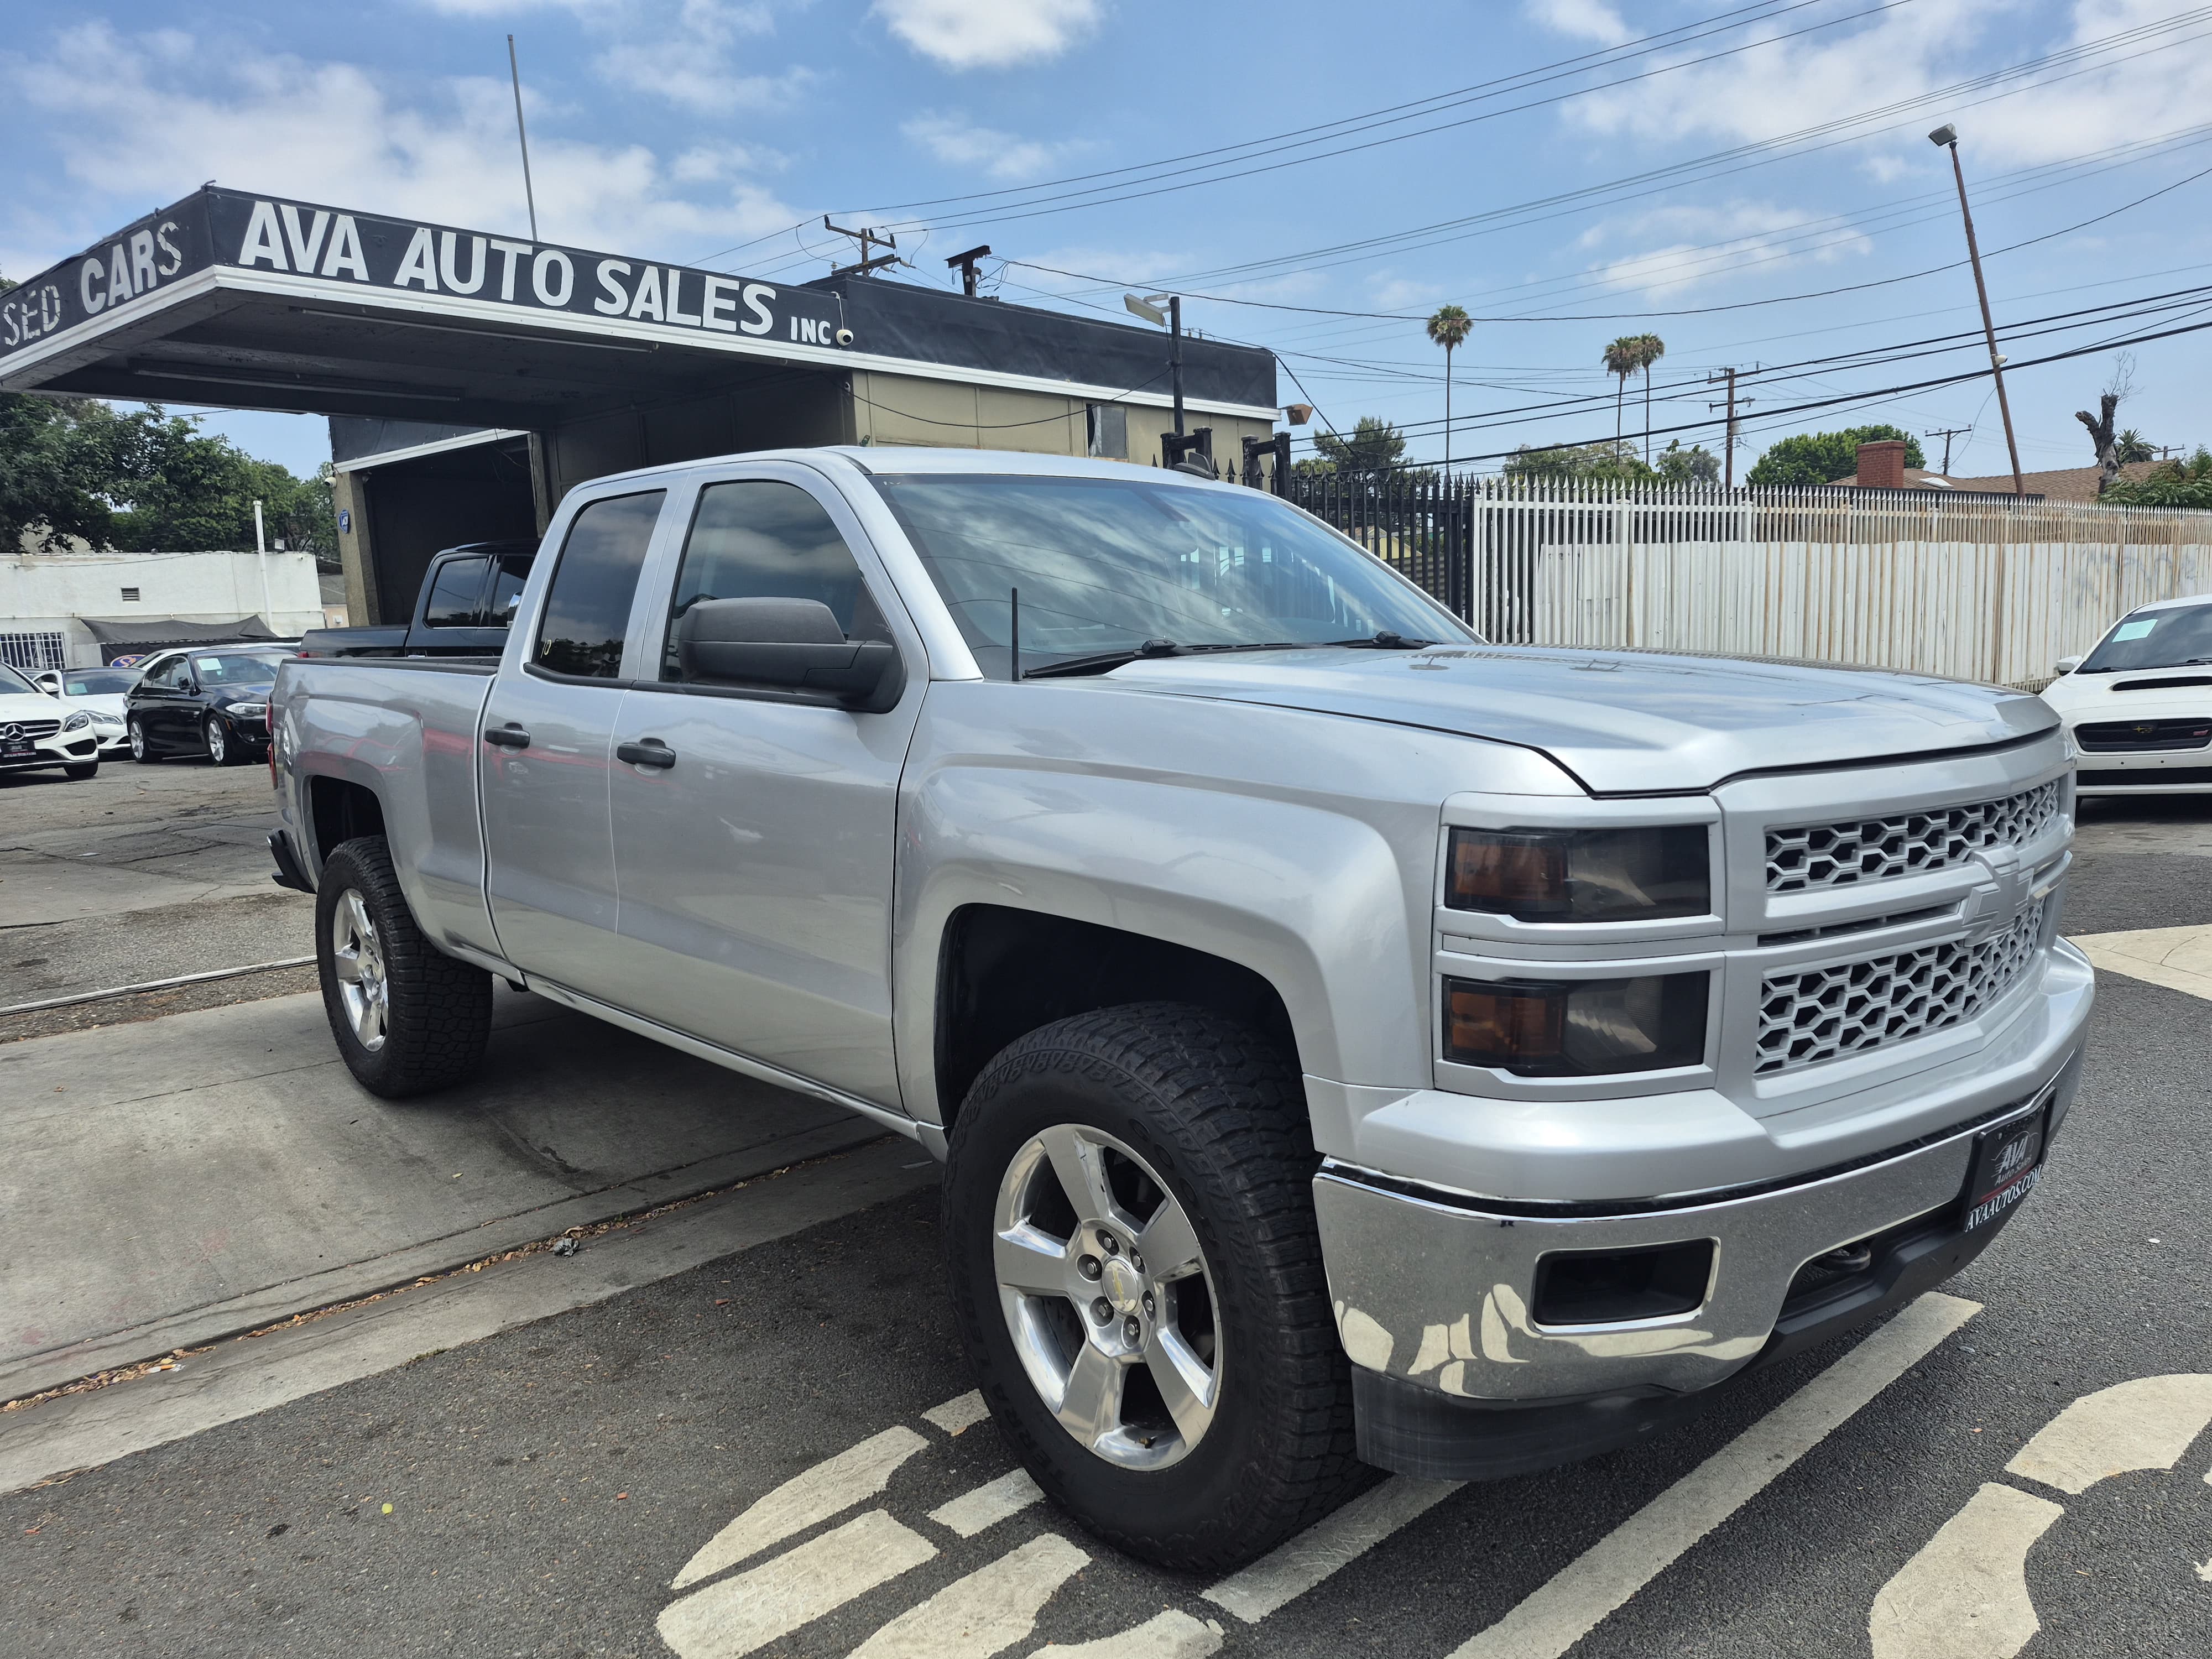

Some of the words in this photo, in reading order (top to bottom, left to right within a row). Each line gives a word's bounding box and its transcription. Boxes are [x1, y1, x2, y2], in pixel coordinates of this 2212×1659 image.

[81, 221, 182, 314] CARS
[238, 200, 370, 281] AVA
[394, 226, 575, 306] AUTO
[593, 259, 777, 335] SALES
[790, 316, 831, 345] INC
[1995, 1168, 2014, 1186] Auto
[1997, 1135, 2028, 1173] AVA
[1965, 1164, 2043, 1233] AVAAUTOS.COM
